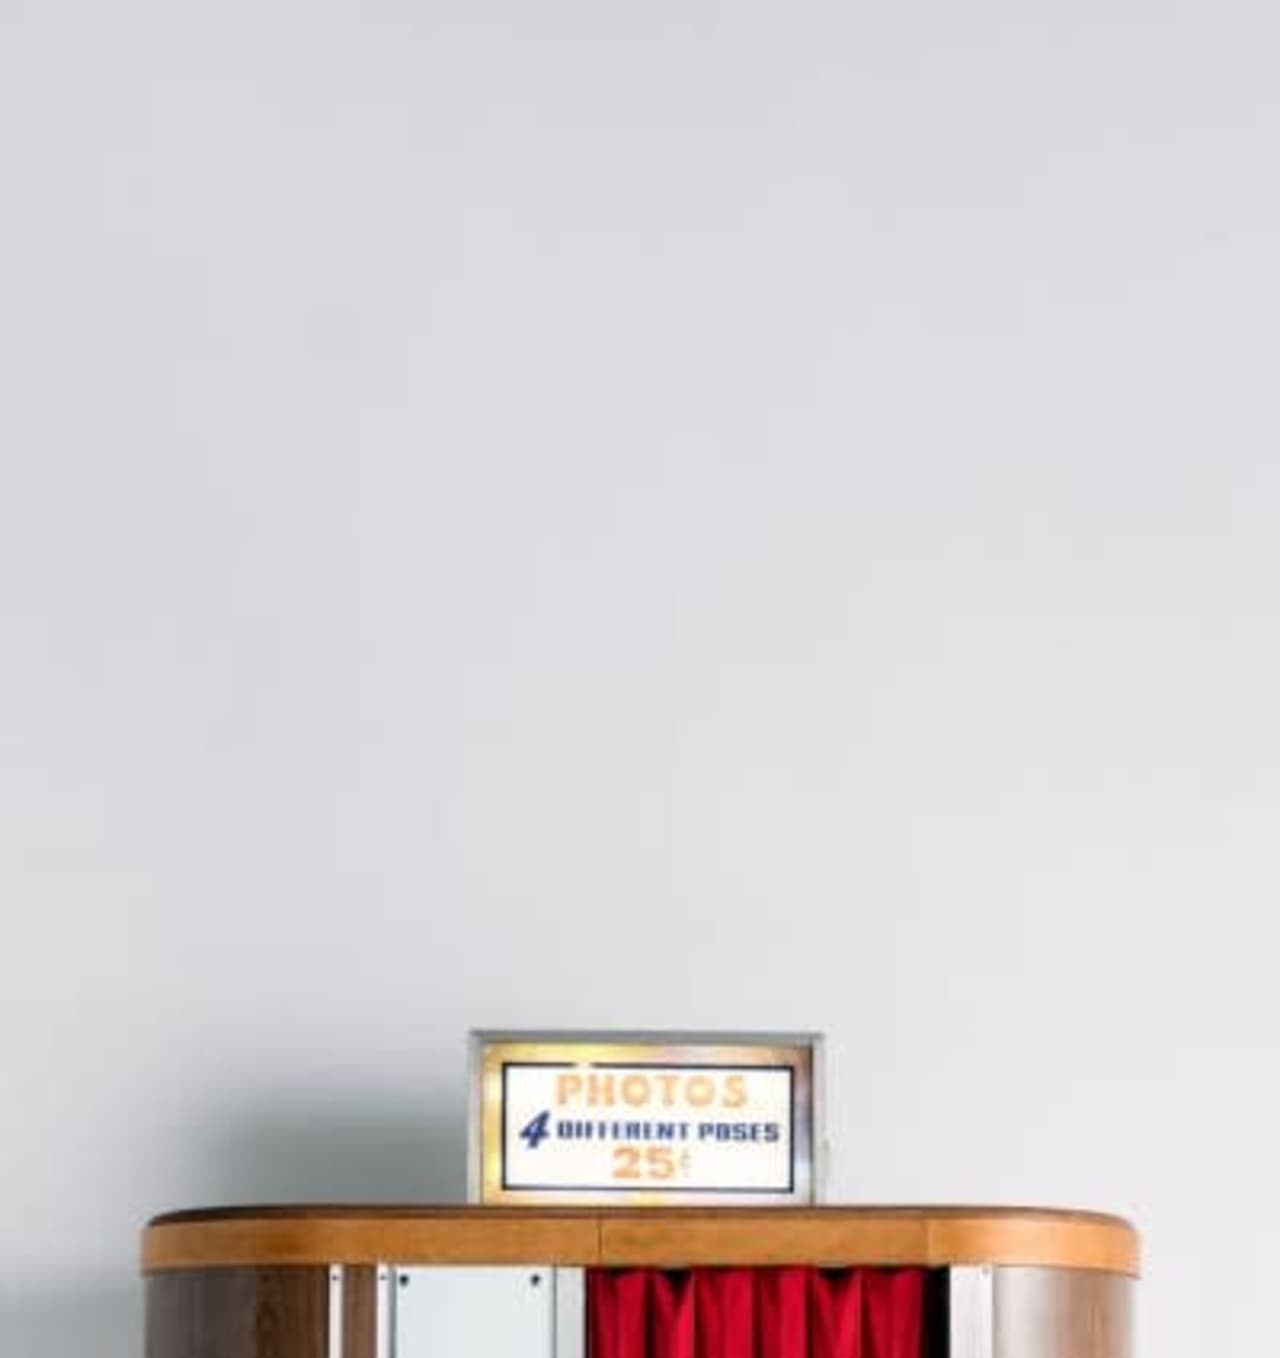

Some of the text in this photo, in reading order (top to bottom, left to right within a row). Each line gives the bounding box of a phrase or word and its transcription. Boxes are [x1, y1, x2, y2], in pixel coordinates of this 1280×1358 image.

[556, 1074, 749, 1108] PHOTOS
[519, 1109, 780, 1149] 4 DIFFERENT POSES
